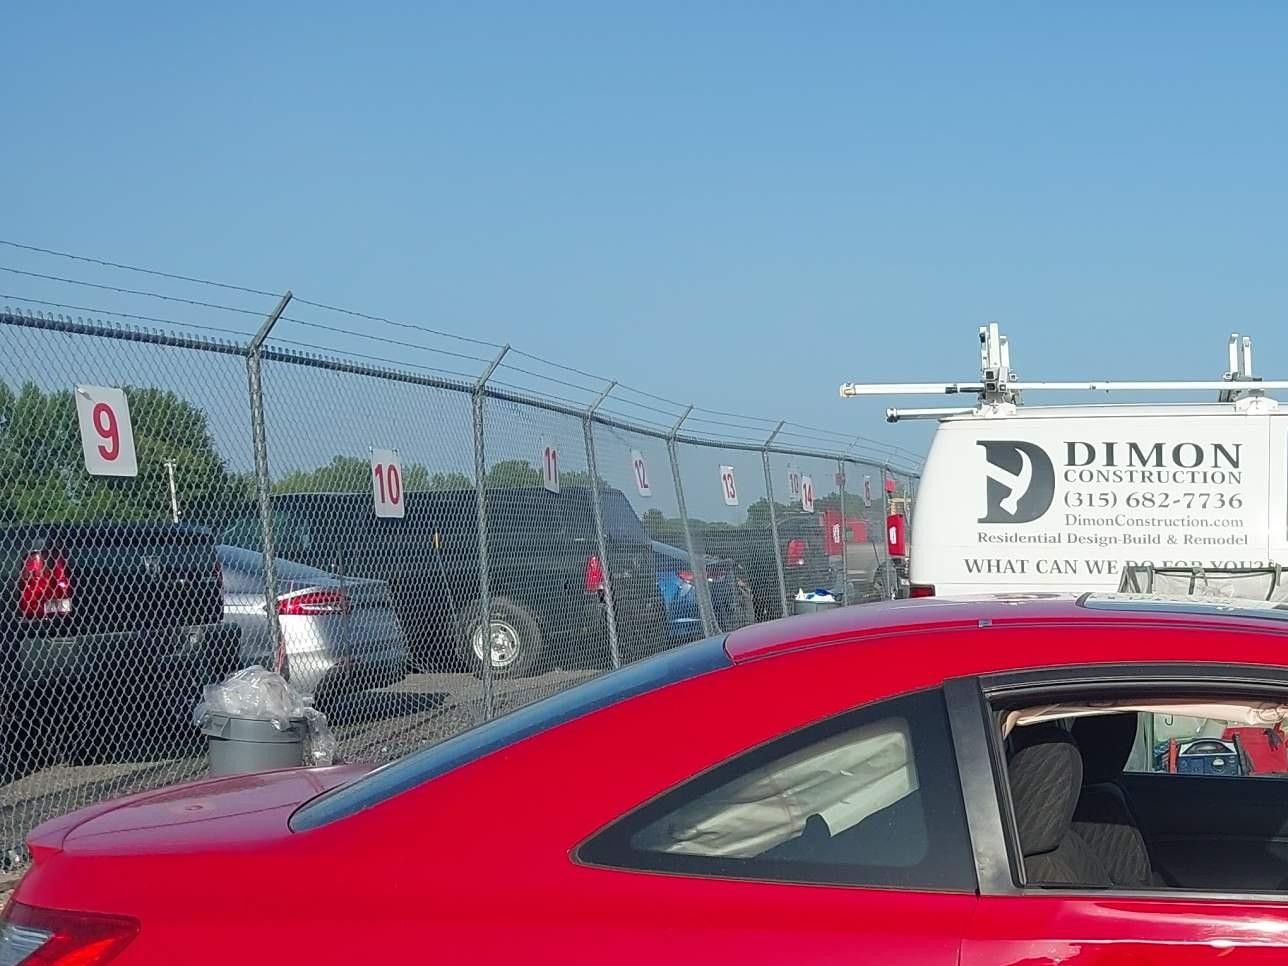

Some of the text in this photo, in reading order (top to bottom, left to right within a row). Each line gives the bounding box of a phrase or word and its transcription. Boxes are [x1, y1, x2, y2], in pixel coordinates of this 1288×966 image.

[92, 402, 120, 461] 9
[545, 447, 558, 484] 11
[1063, 441, 1244, 469] DIMON
[374, 463, 401, 505] 10
[634, 459, 649, 489] 12
[722, 473, 736, 499] 13
[1063, 469, 1243, 485] CONSTRUCTION
[803, 483, 813, 506] 14
[1063, 491, 1243, 509] (315) 682-7736
[1065, 513, 1245, 528] DimonConstruction.com
[977, 531, 1248, 548] Residential Design-Build & Remodel
[964, 558, 1030, 574] WHAT
[1035, 559, 1079, 575] CAN
[1084, 559, 1119, 575] WE
